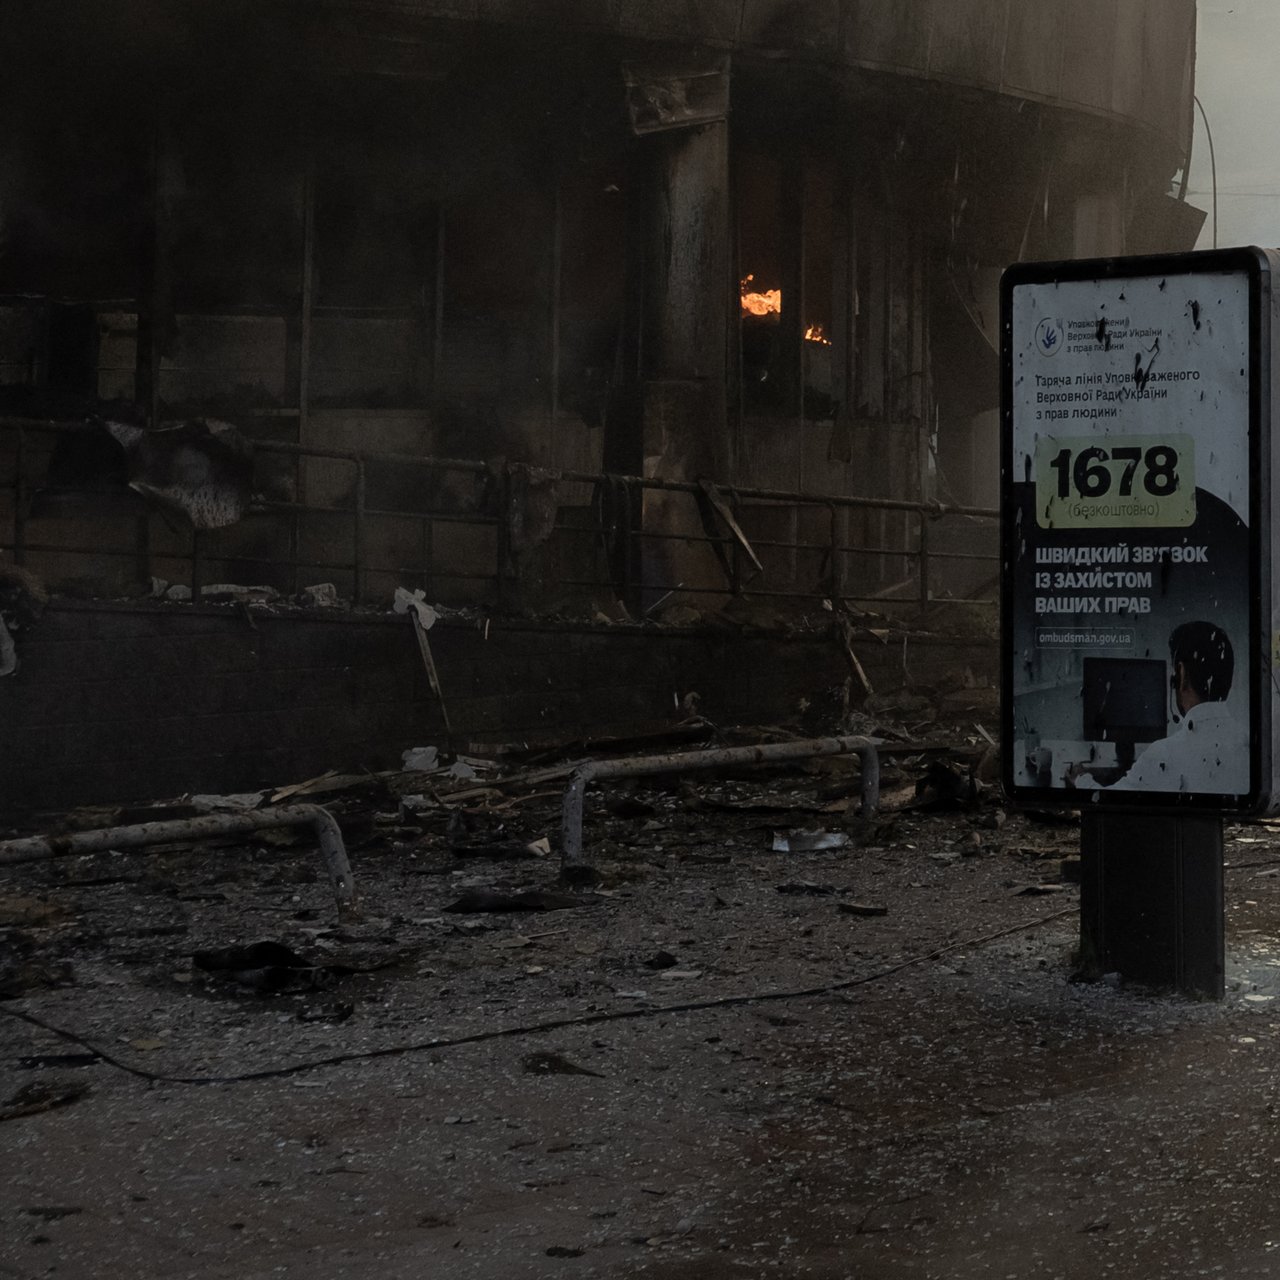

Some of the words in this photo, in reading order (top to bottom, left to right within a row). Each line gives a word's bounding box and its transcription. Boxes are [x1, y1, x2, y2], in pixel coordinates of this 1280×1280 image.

[1129, 328, 1162, 338] України
[1066, 345, 1072, 353] з
[1073, 344, 1092, 354] прав
[1093, 343, 1125, 352] люини
[1036, 375, 1071, 387] Гаряча
[1075, 372, 1103, 384] лінія
[1036, 390, 1092, 405] Верховної
[1096, 390, 1120, 403] Ради
[1124, 388, 1167, 402] України
[1036, 410, 1042, 420] з
[1045, 409, 1069, 421] прав
[1072, 408, 1117, 419] людини
[1050, 445, 1179, 498] 1678
[1068, 500, 1160, 518] (безкоштовно)
[1035, 542, 1130, 566] ШВИДКИЙ
[1035, 572, 1051, 588] ІЗ
[1054, 571, 1153, 588] ЗАХИСТОМ
[1035, 597, 1101, 613] ВАШИХ
[1104, 597, 1152, 613] ПРАВ
[1039, 632, 1131, 645] ombudsman.gov.ua
